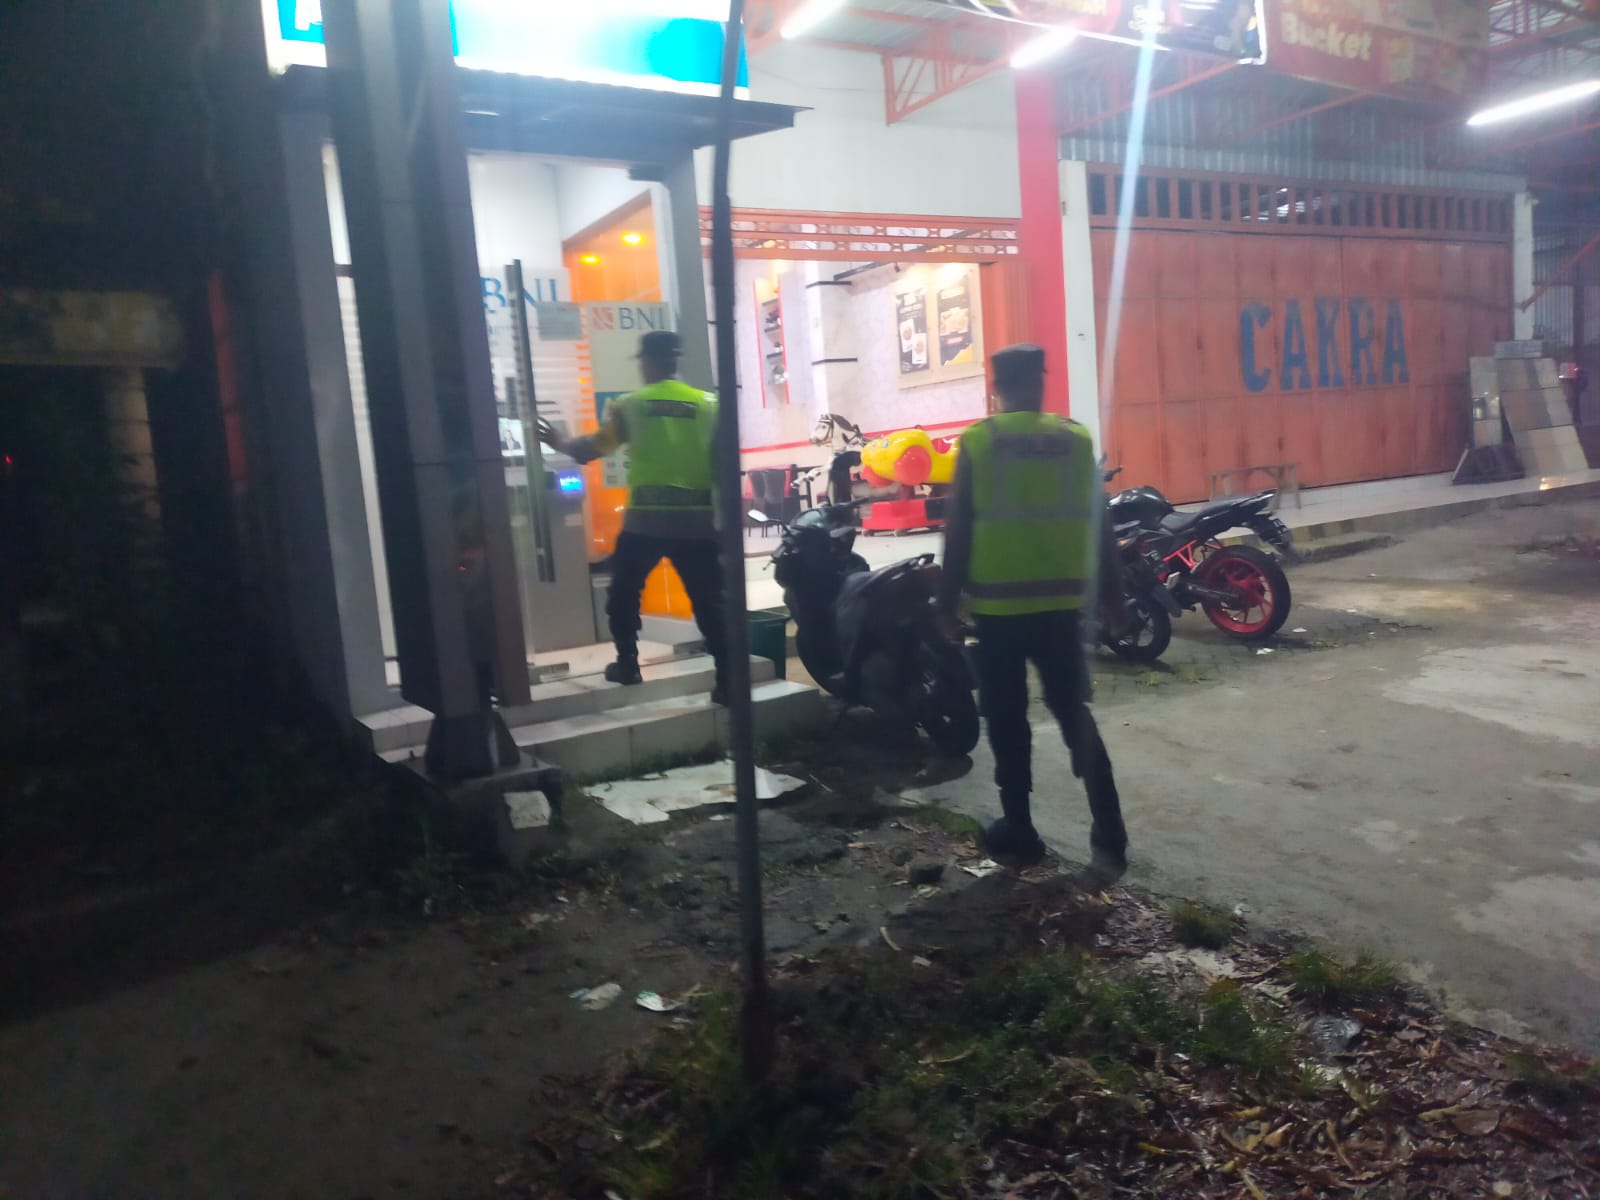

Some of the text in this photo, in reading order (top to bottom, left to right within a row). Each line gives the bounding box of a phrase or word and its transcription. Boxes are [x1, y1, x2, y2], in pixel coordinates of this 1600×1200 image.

[1281, 12, 1372, 61] Bucket
[618, 307, 665, 330] BNI
[1239, 296, 1410, 393] CAKRA
